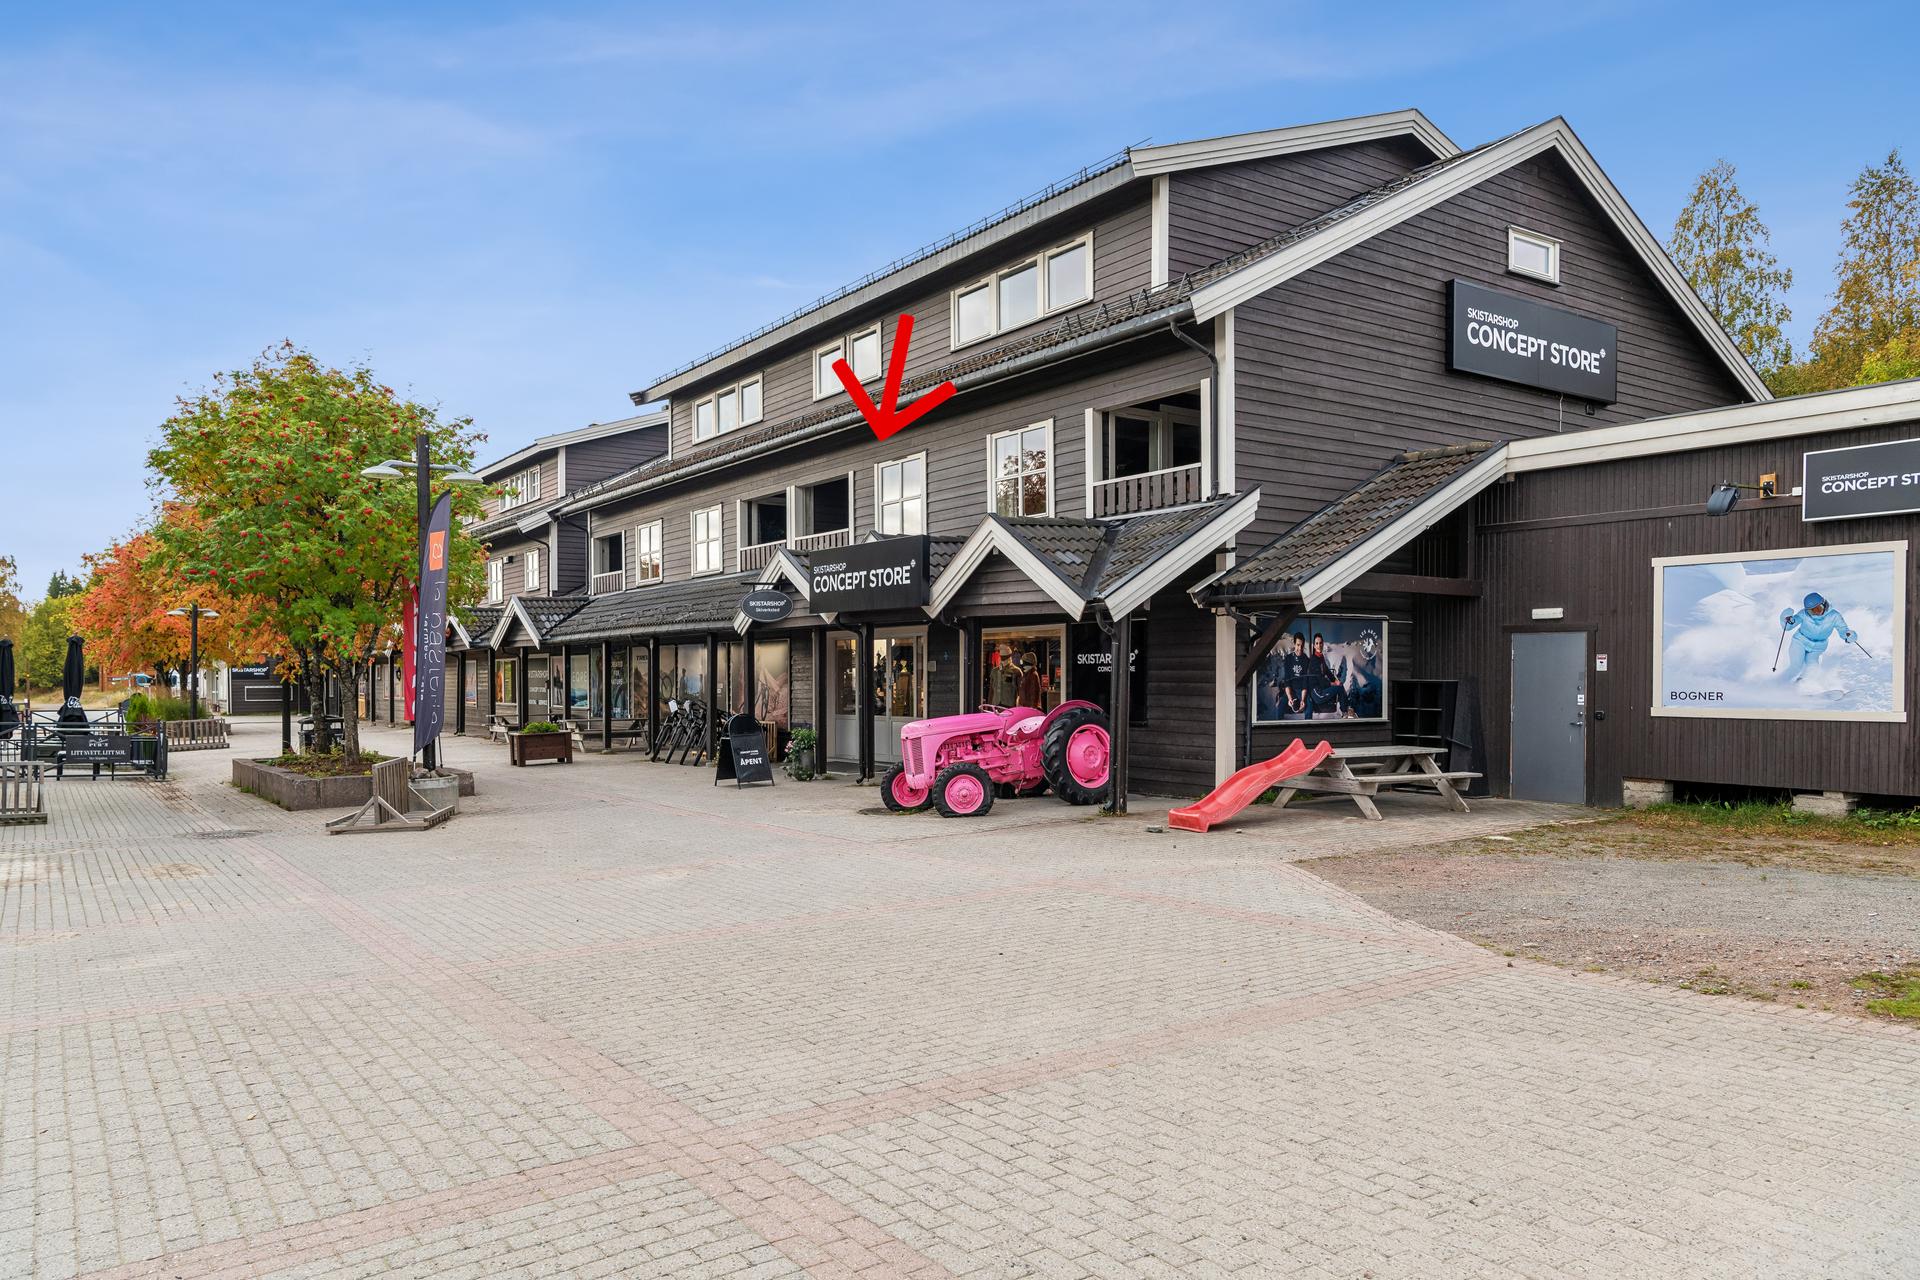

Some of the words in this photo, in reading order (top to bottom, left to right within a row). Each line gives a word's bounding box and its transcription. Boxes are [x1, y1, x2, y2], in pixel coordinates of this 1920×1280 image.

[1467, 307, 1519, 329] SKISTARSHOP
[1467, 322, 1548, 361] CONCEPT
[1550, 342, 1600, 374] STORE
[1821, 471, 1869, 482] SKISTARSHOP
[1821, 475, 1898, 493] CONCEPT
[813, 562, 847, 574] SKISTARSHOP
[813, 570, 867, 593] CONCEPT
[869, 565, 911, 588] STORE
[1077, 652, 1136, 665] SKISTARP
[1670, 691, 1724, 701] BOGNER
